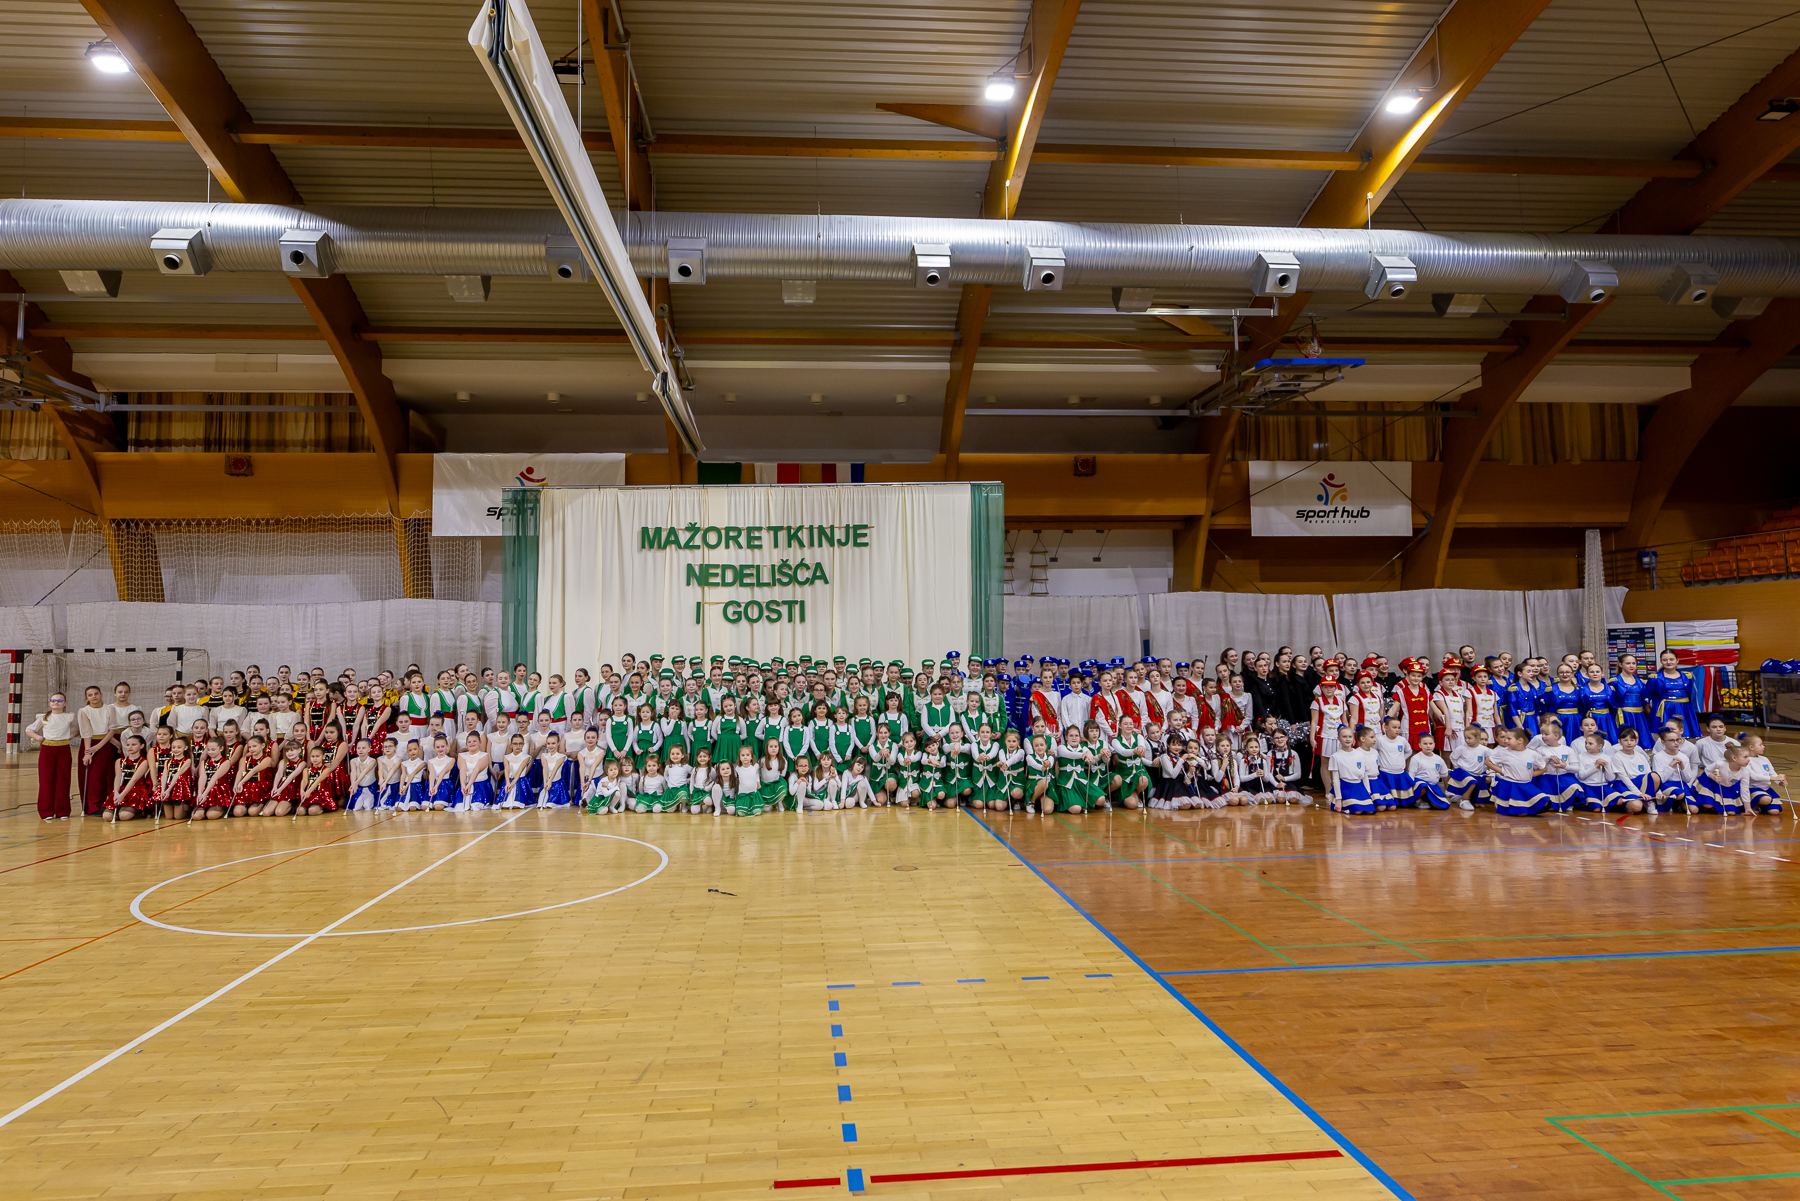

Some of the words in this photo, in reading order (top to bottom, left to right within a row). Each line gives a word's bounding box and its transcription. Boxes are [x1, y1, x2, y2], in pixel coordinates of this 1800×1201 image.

[641, 522, 869, 550] MAŽORETKINJE
[686, 558, 829, 587] NEDELIŠĆA
[696, 601, 702, 624] I
[722, 600, 806, 624] GOSTI
